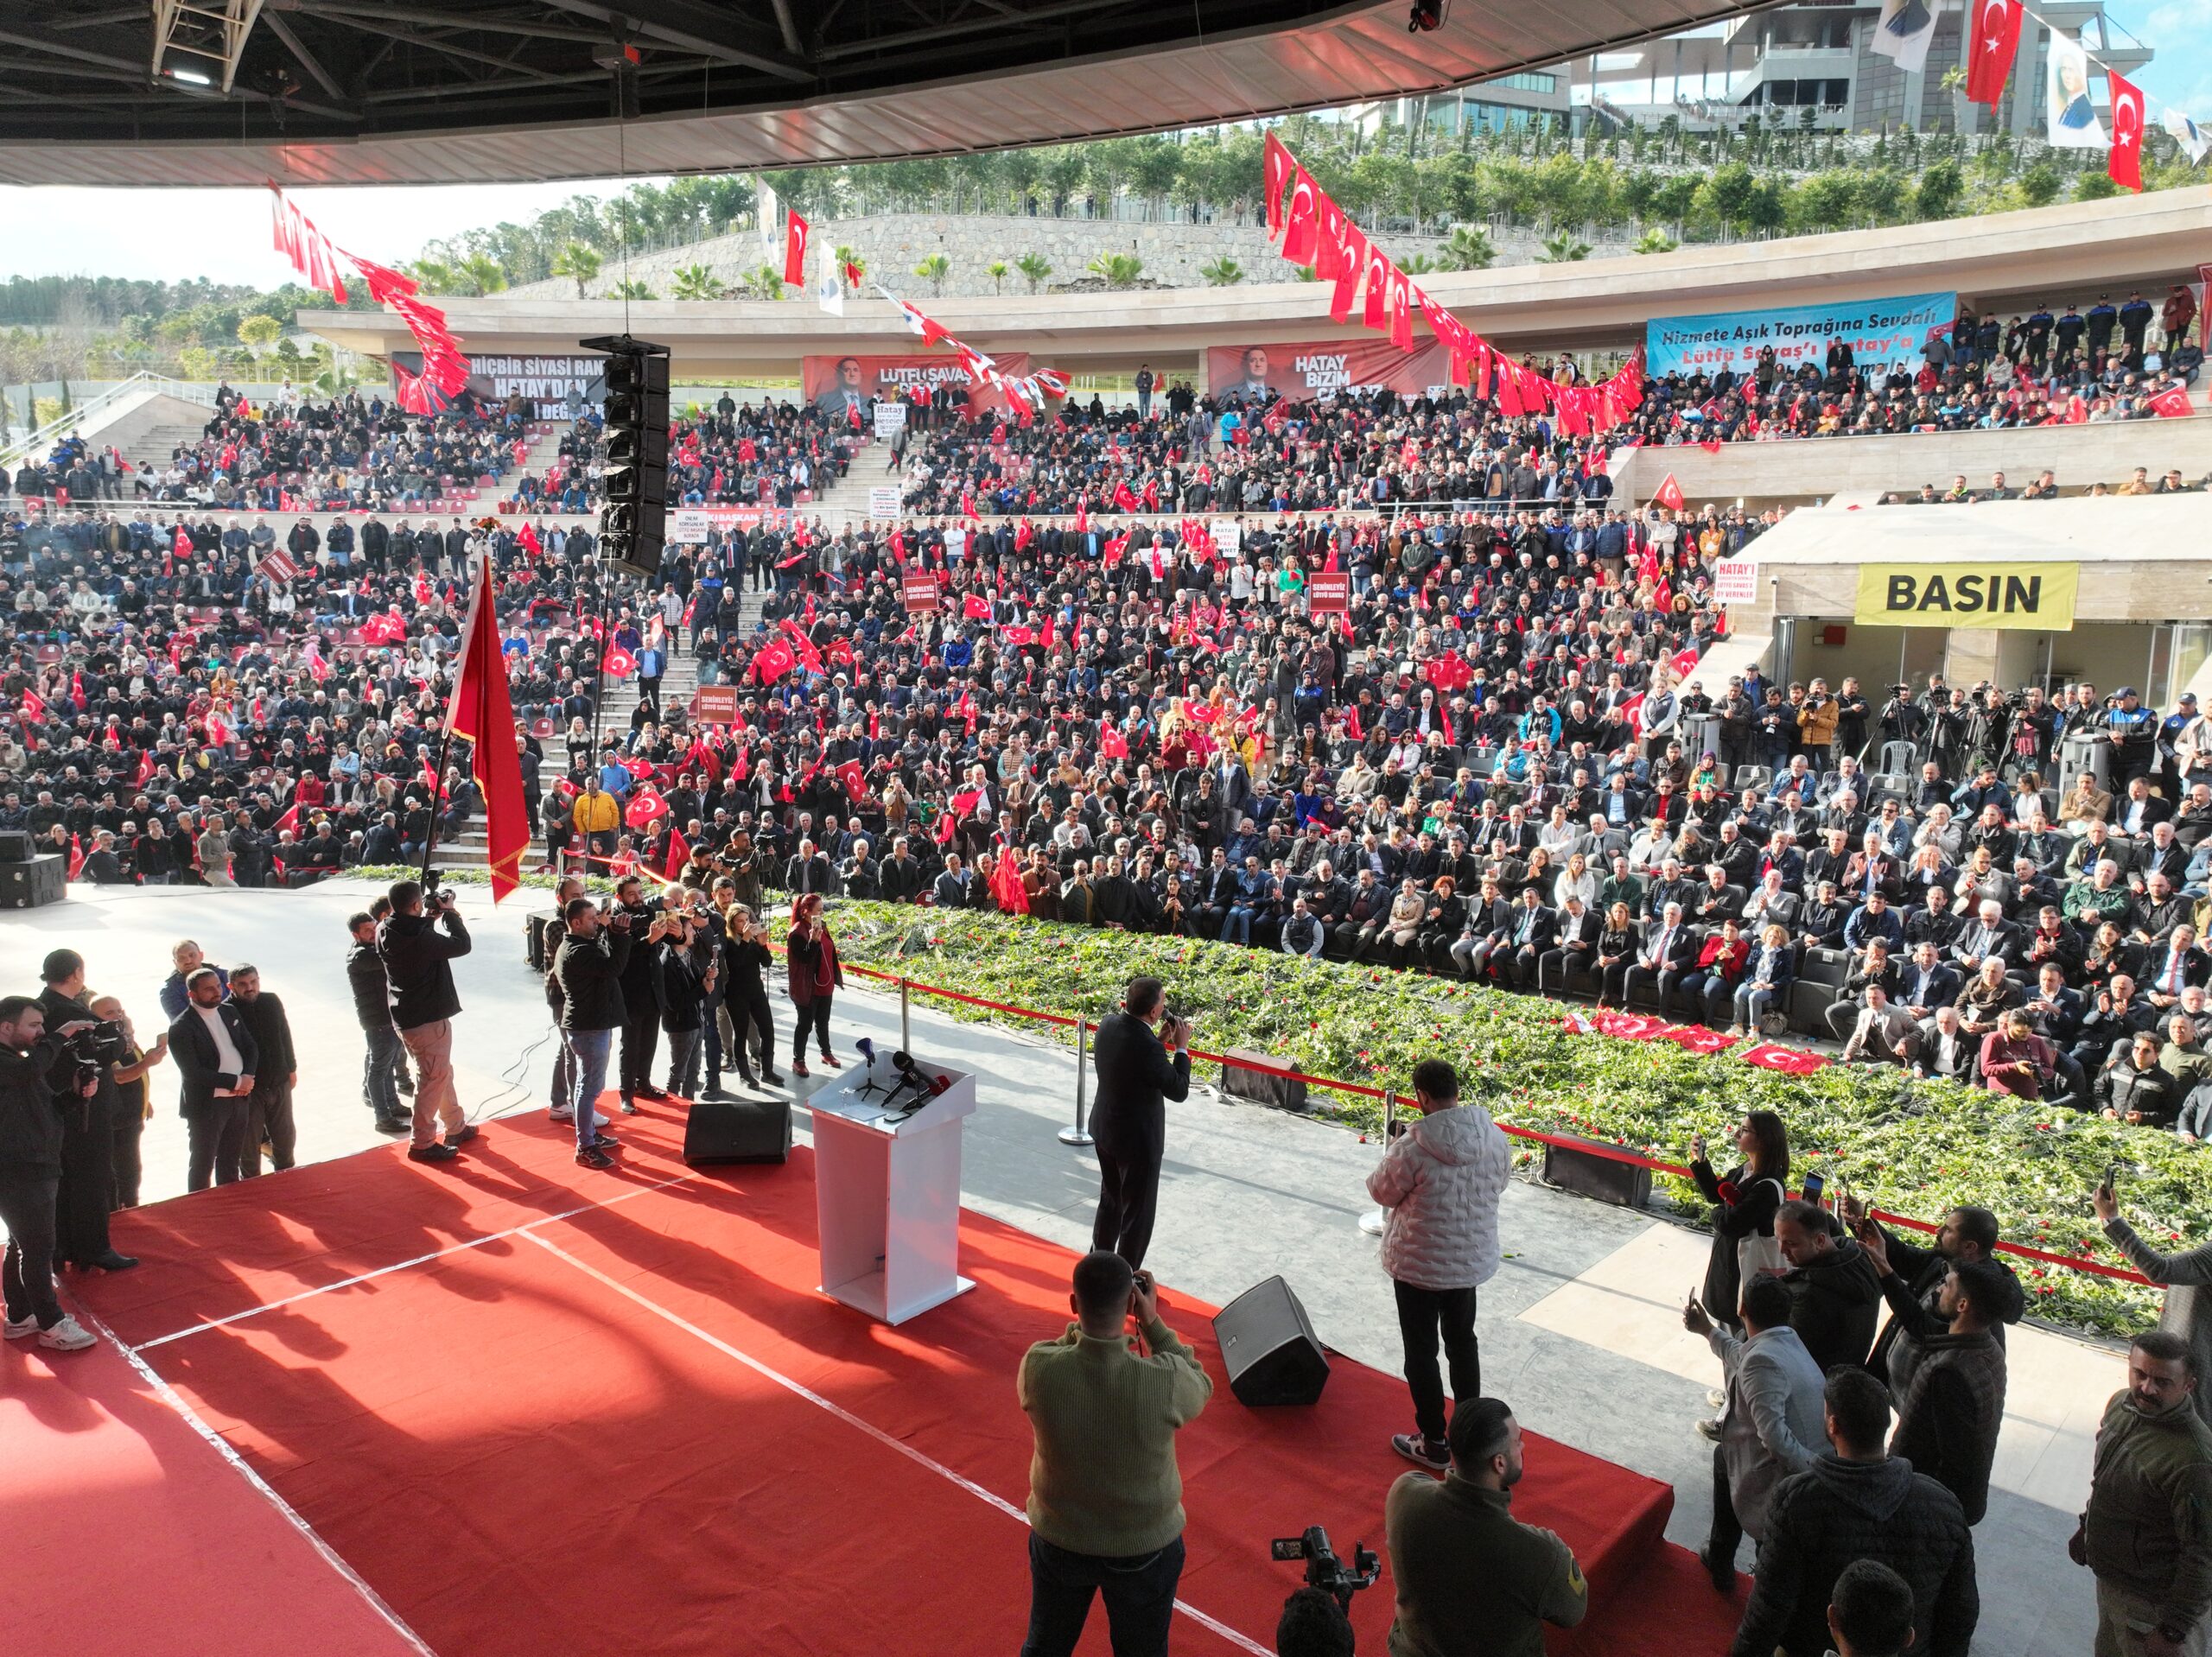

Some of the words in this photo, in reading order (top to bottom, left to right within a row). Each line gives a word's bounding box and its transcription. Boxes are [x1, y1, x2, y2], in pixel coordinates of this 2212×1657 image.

[1662, 325, 1728, 346] Hizmete
[1732, 324, 1770, 342] Aşık
[1775, 314, 1862, 337] Toprağına
[1868, 308, 1936, 328] Sevdalı
[1296, 354, 1348, 372] HATAY
[1682, 347, 1735, 364] Lütfü
[472, 357, 523, 378] HİÇBİR
[524, 356, 572, 376] SİYASİ
[575, 359, 606, 377] RAN
[928, 367, 972, 385] SAVAŞ
[495, 378, 588, 398] HATAY'DAN
[877, 406, 904, 415] Hatay
[1719, 563, 1755, 575] HATAY'I
[906, 584, 935, 594] SENİNLEYİZ
[1313, 582, 1345, 591] SENİNLEYİZ
[1885, 575, 2042, 613] BASIN
[701, 695, 734, 704] SENİNLEYİZ
